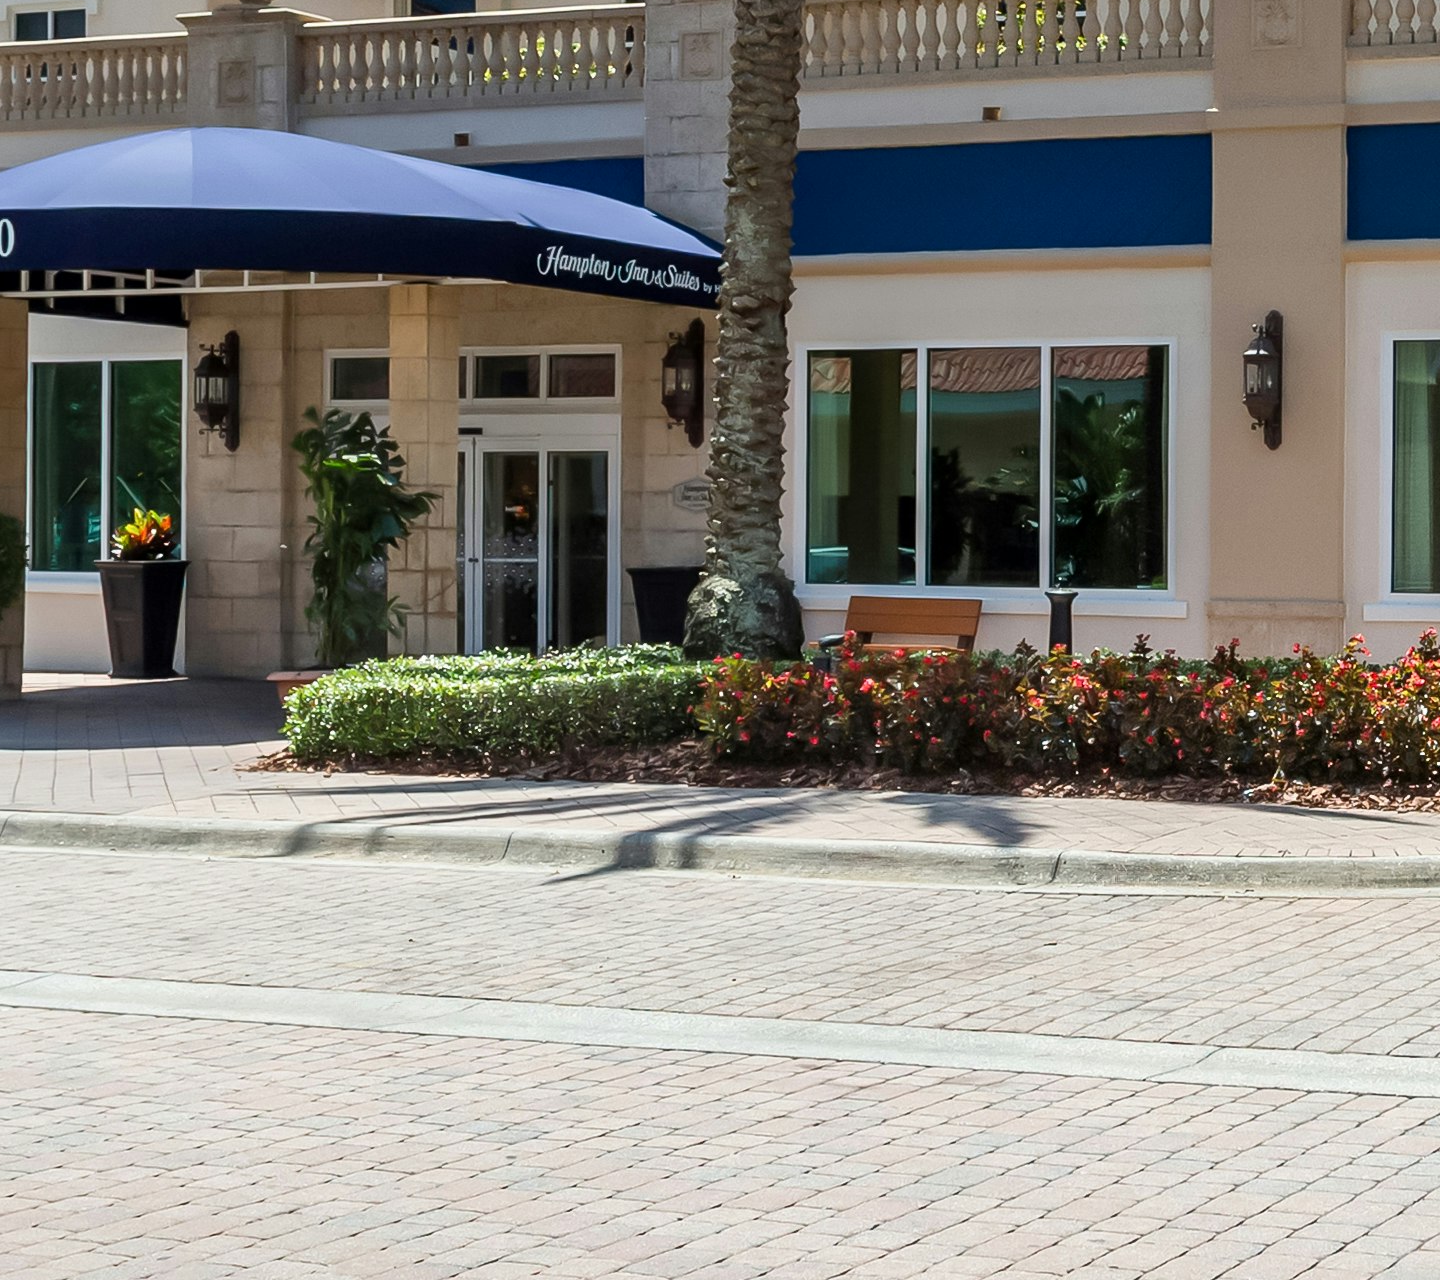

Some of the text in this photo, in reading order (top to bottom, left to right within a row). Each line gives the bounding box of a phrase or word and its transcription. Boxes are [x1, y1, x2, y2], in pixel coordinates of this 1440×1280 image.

[536, 245, 713, 294] Hampton Inn & Suites by
